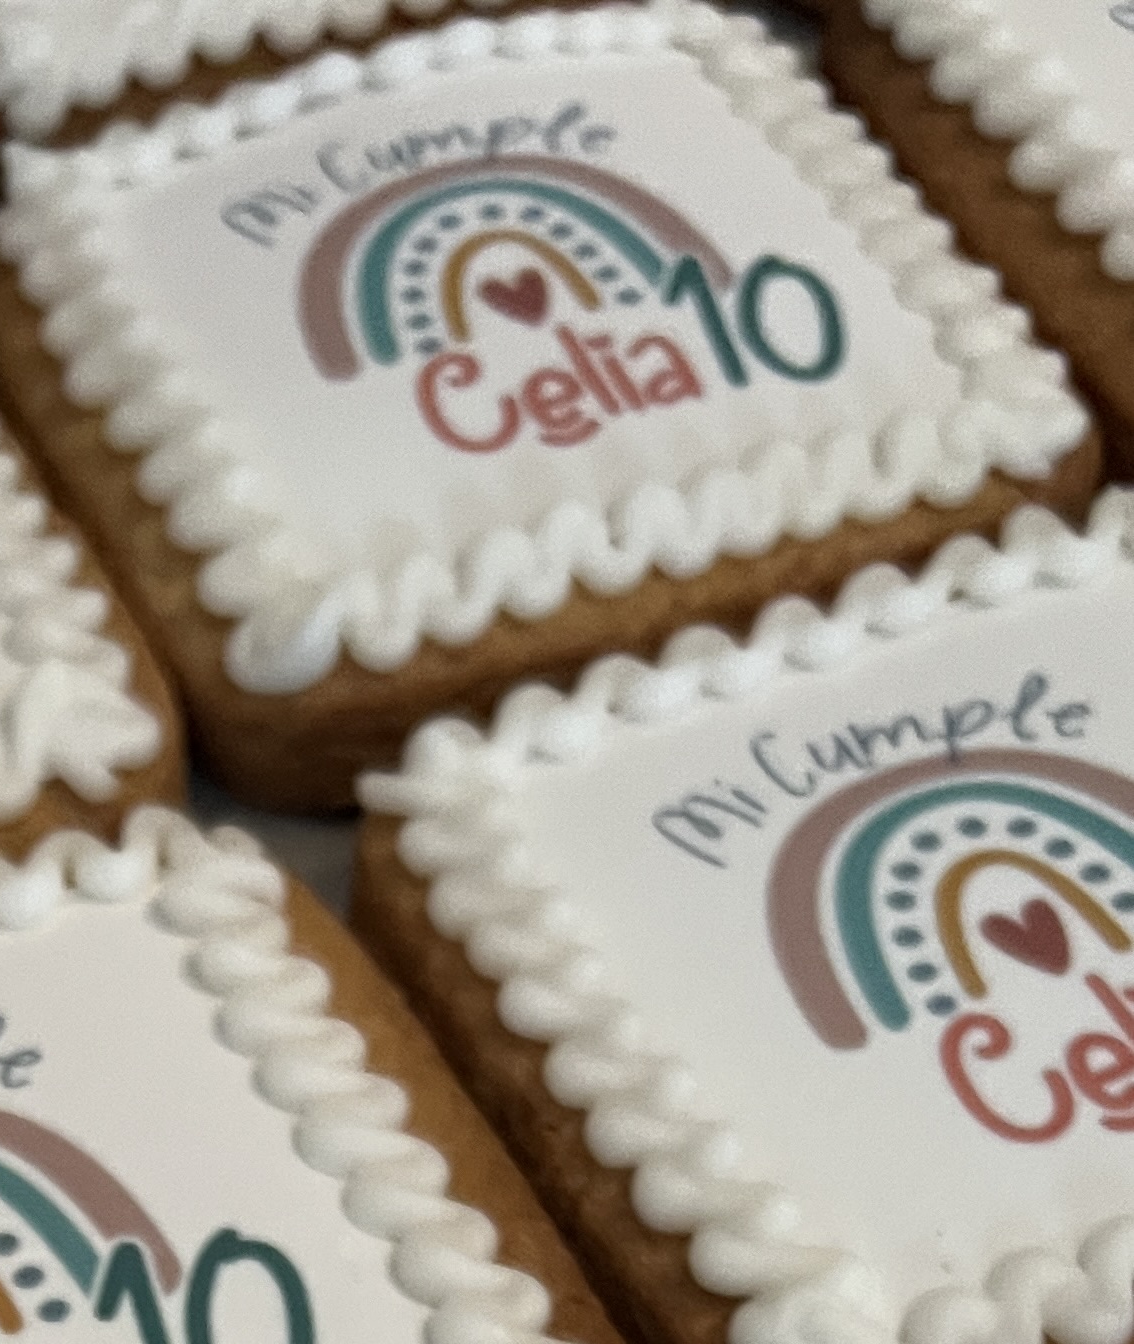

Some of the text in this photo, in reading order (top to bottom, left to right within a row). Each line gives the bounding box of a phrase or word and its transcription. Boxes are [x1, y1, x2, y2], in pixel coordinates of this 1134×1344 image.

[316, 104, 618, 192] Cumple
[417, 254, 847, 454] Celia 10
[651, 672, 1092, 868] Mi Cumple
